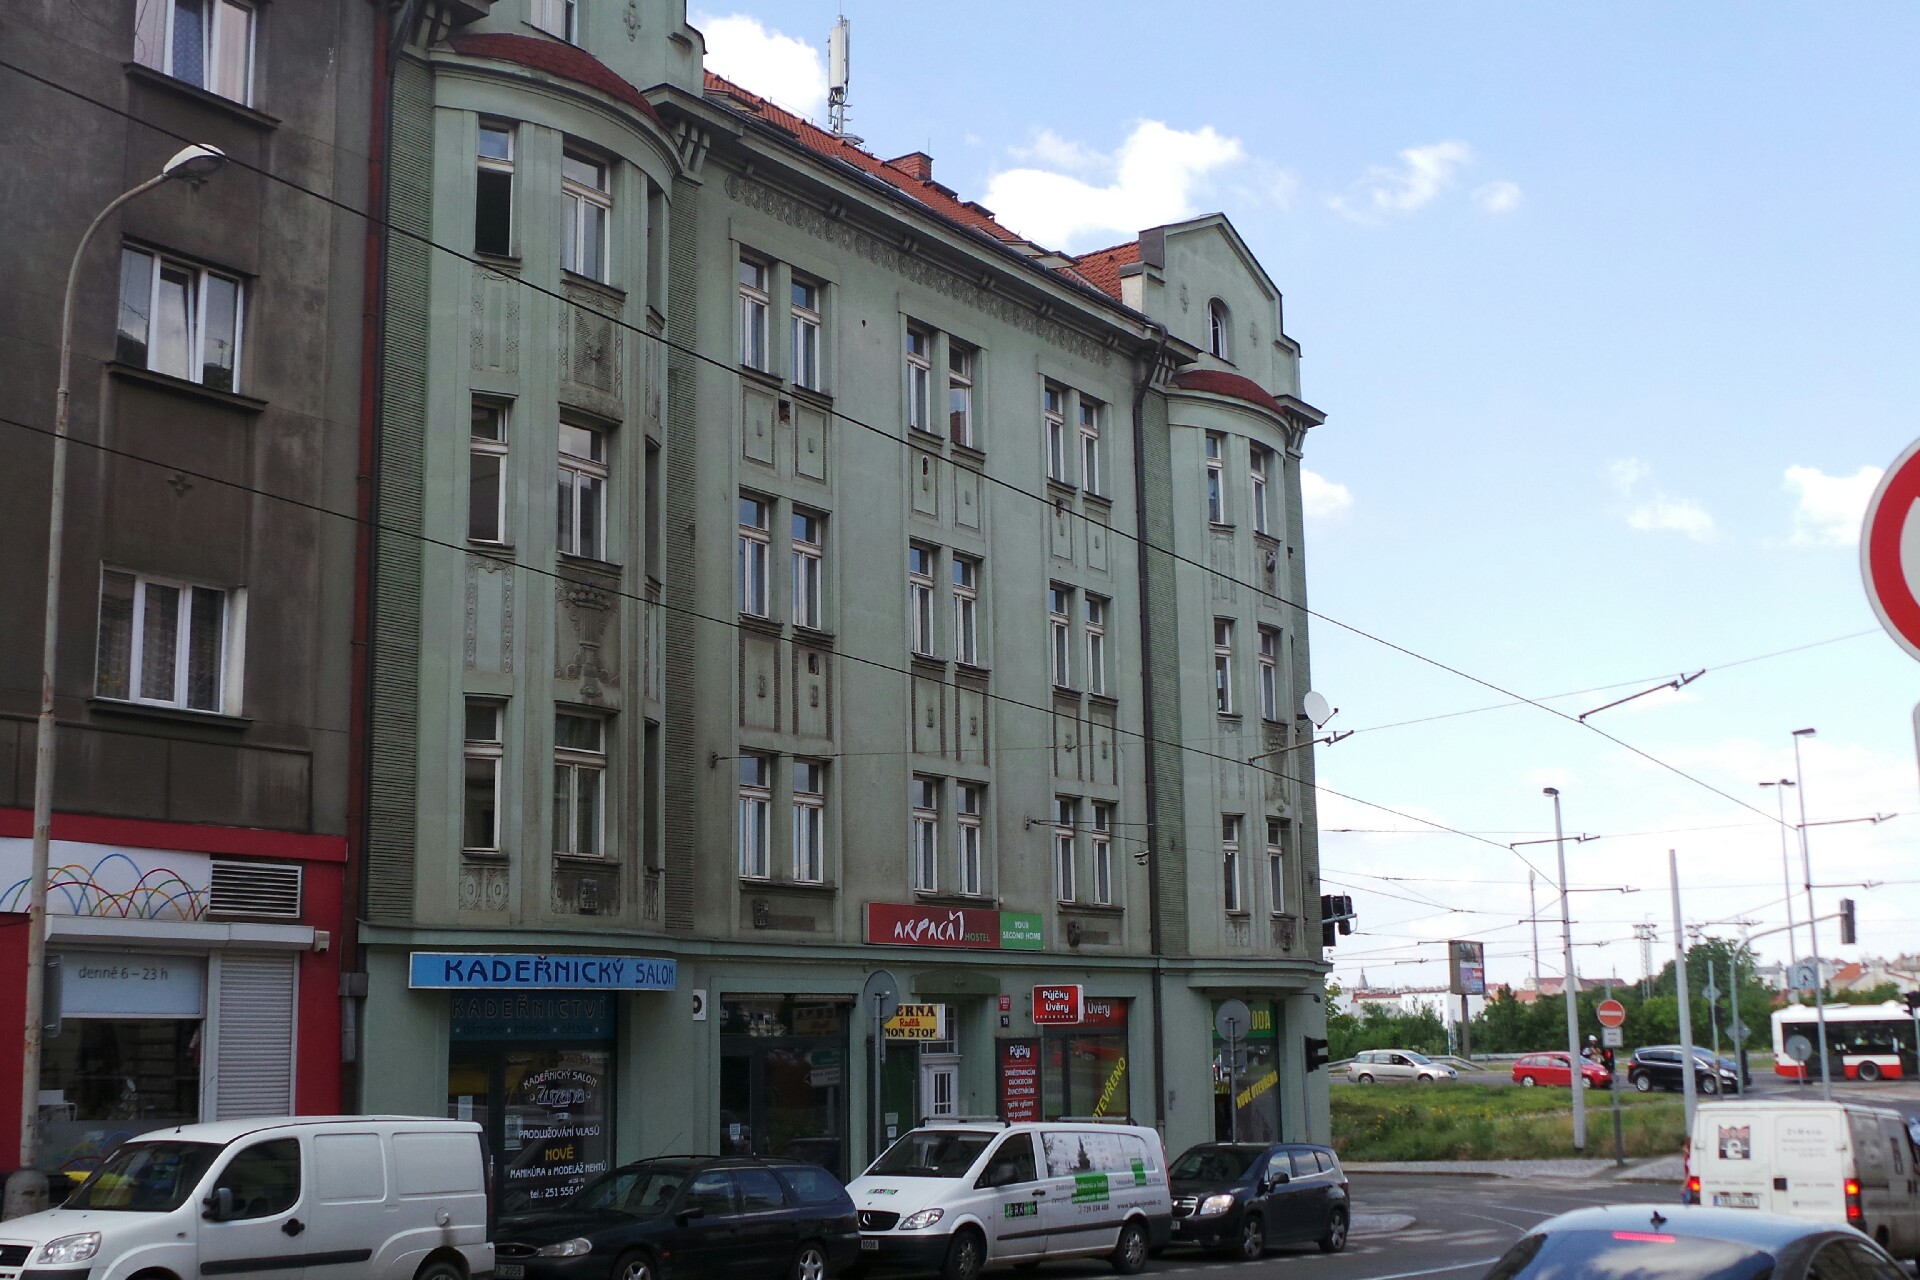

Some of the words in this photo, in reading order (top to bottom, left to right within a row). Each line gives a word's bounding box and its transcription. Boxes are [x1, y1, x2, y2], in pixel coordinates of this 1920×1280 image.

[1014, 921, 1029, 929] YOUR
[965, 932, 991, 943] HOSTEL
[1002, 931, 1024, 940] SECOND
[1025, 932, 1041, 941] HOME
[78, 966, 118, 980] denně
[121, 968, 129, 980] 6
[142, 968, 157, 980] 23
[160, 967, 168, 980] h
[444, 955, 624, 984] KADEŘNICKÝ
[635, 961, 673, 985] SALON
[1042, 989, 1069, 1000] Půjčky
[452, 994, 607, 1019] KADEŘNICTVÍ
[896, 1005, 936, 1017] ERNA
[1045, 1000, 1069, 1013] Úvěry
[1087, 1000, 1110, 1017] Úvěry
[1249, 1010, 1271, 1030] ODA
[885, 1029, 905, 1037] NON
[908, 1029, 936, 1038] STOP
[1009, 1045, 1030, 1058] Půjčky
[522, 1069, 571, 1090] KADEŘNICKÝ
[572, 1071, 598, 1088] SALON
[519, 1122, 575, 1140] PRODLUŽOVÁNÍ
[545, 1144, 574, 1161] NOVĚ
[545, 1187, 559, 1198] 251
[560, 1186, 574, 1196] 556
